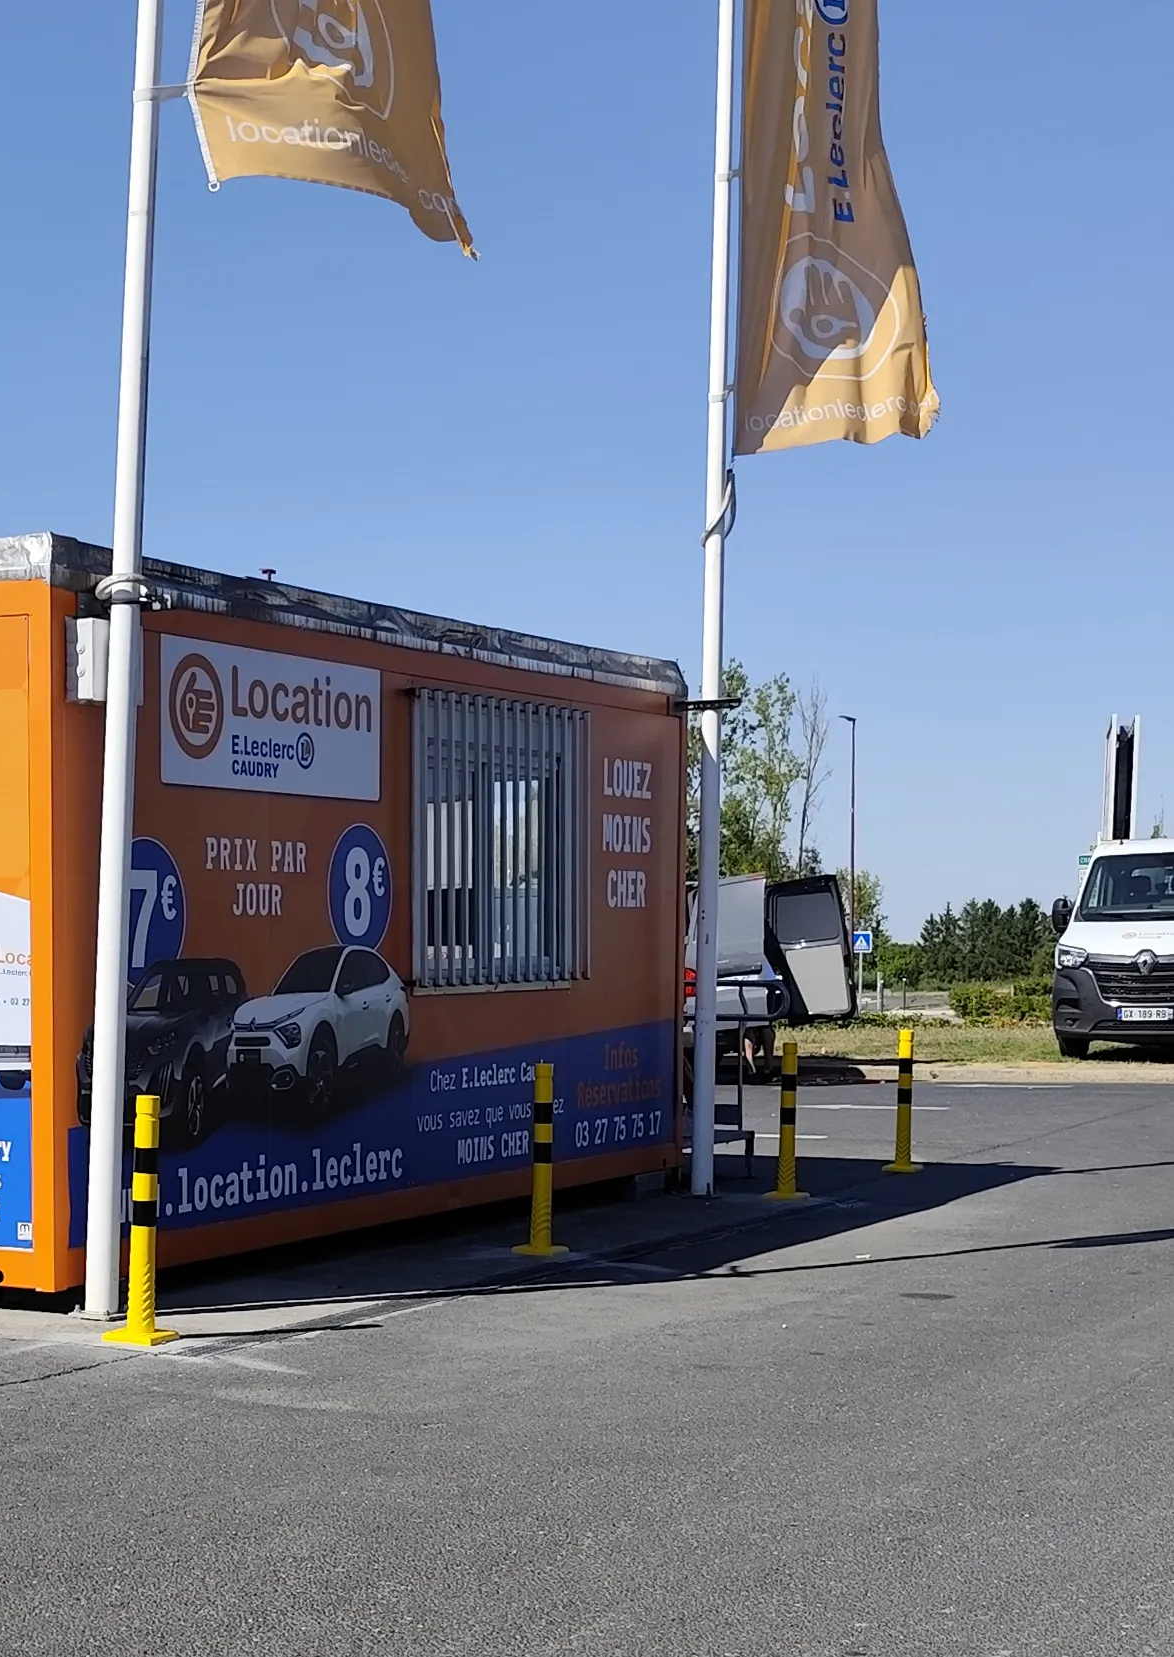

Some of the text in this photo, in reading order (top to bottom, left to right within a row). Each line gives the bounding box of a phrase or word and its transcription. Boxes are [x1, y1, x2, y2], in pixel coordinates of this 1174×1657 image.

[231, 665, 372, 733] Location
[231, 734, 295, 762] E.Leclerc
[231, 759, 279, 778] CAUDRY
[603, 757, 652, 800] LOUEZ
[602, 813, 652, 854] MOINS
[205, 837, 307, 874] PRIX PAR
[232, 882, 282, 917] JOUR
[607, 868, 646, 908] CHER
[604, 1041, 638, 1071] Infos
[430, 1068, 456, 1092] Chez
[461, 1063, 516, 1089] E.Leclerc
[577, 1072, 662, 1109] Réservations
[417, 1113, 443, 1132] vous
[449, 1108, 480, 1129] savez
[485, 1104, 504, 1129] que
[509, 1102, 532, 1120] vous
[575, 1110, 662, 1148] 03 27 75 75 17
[457, 1130, 529, 1165] MOINS CHER
